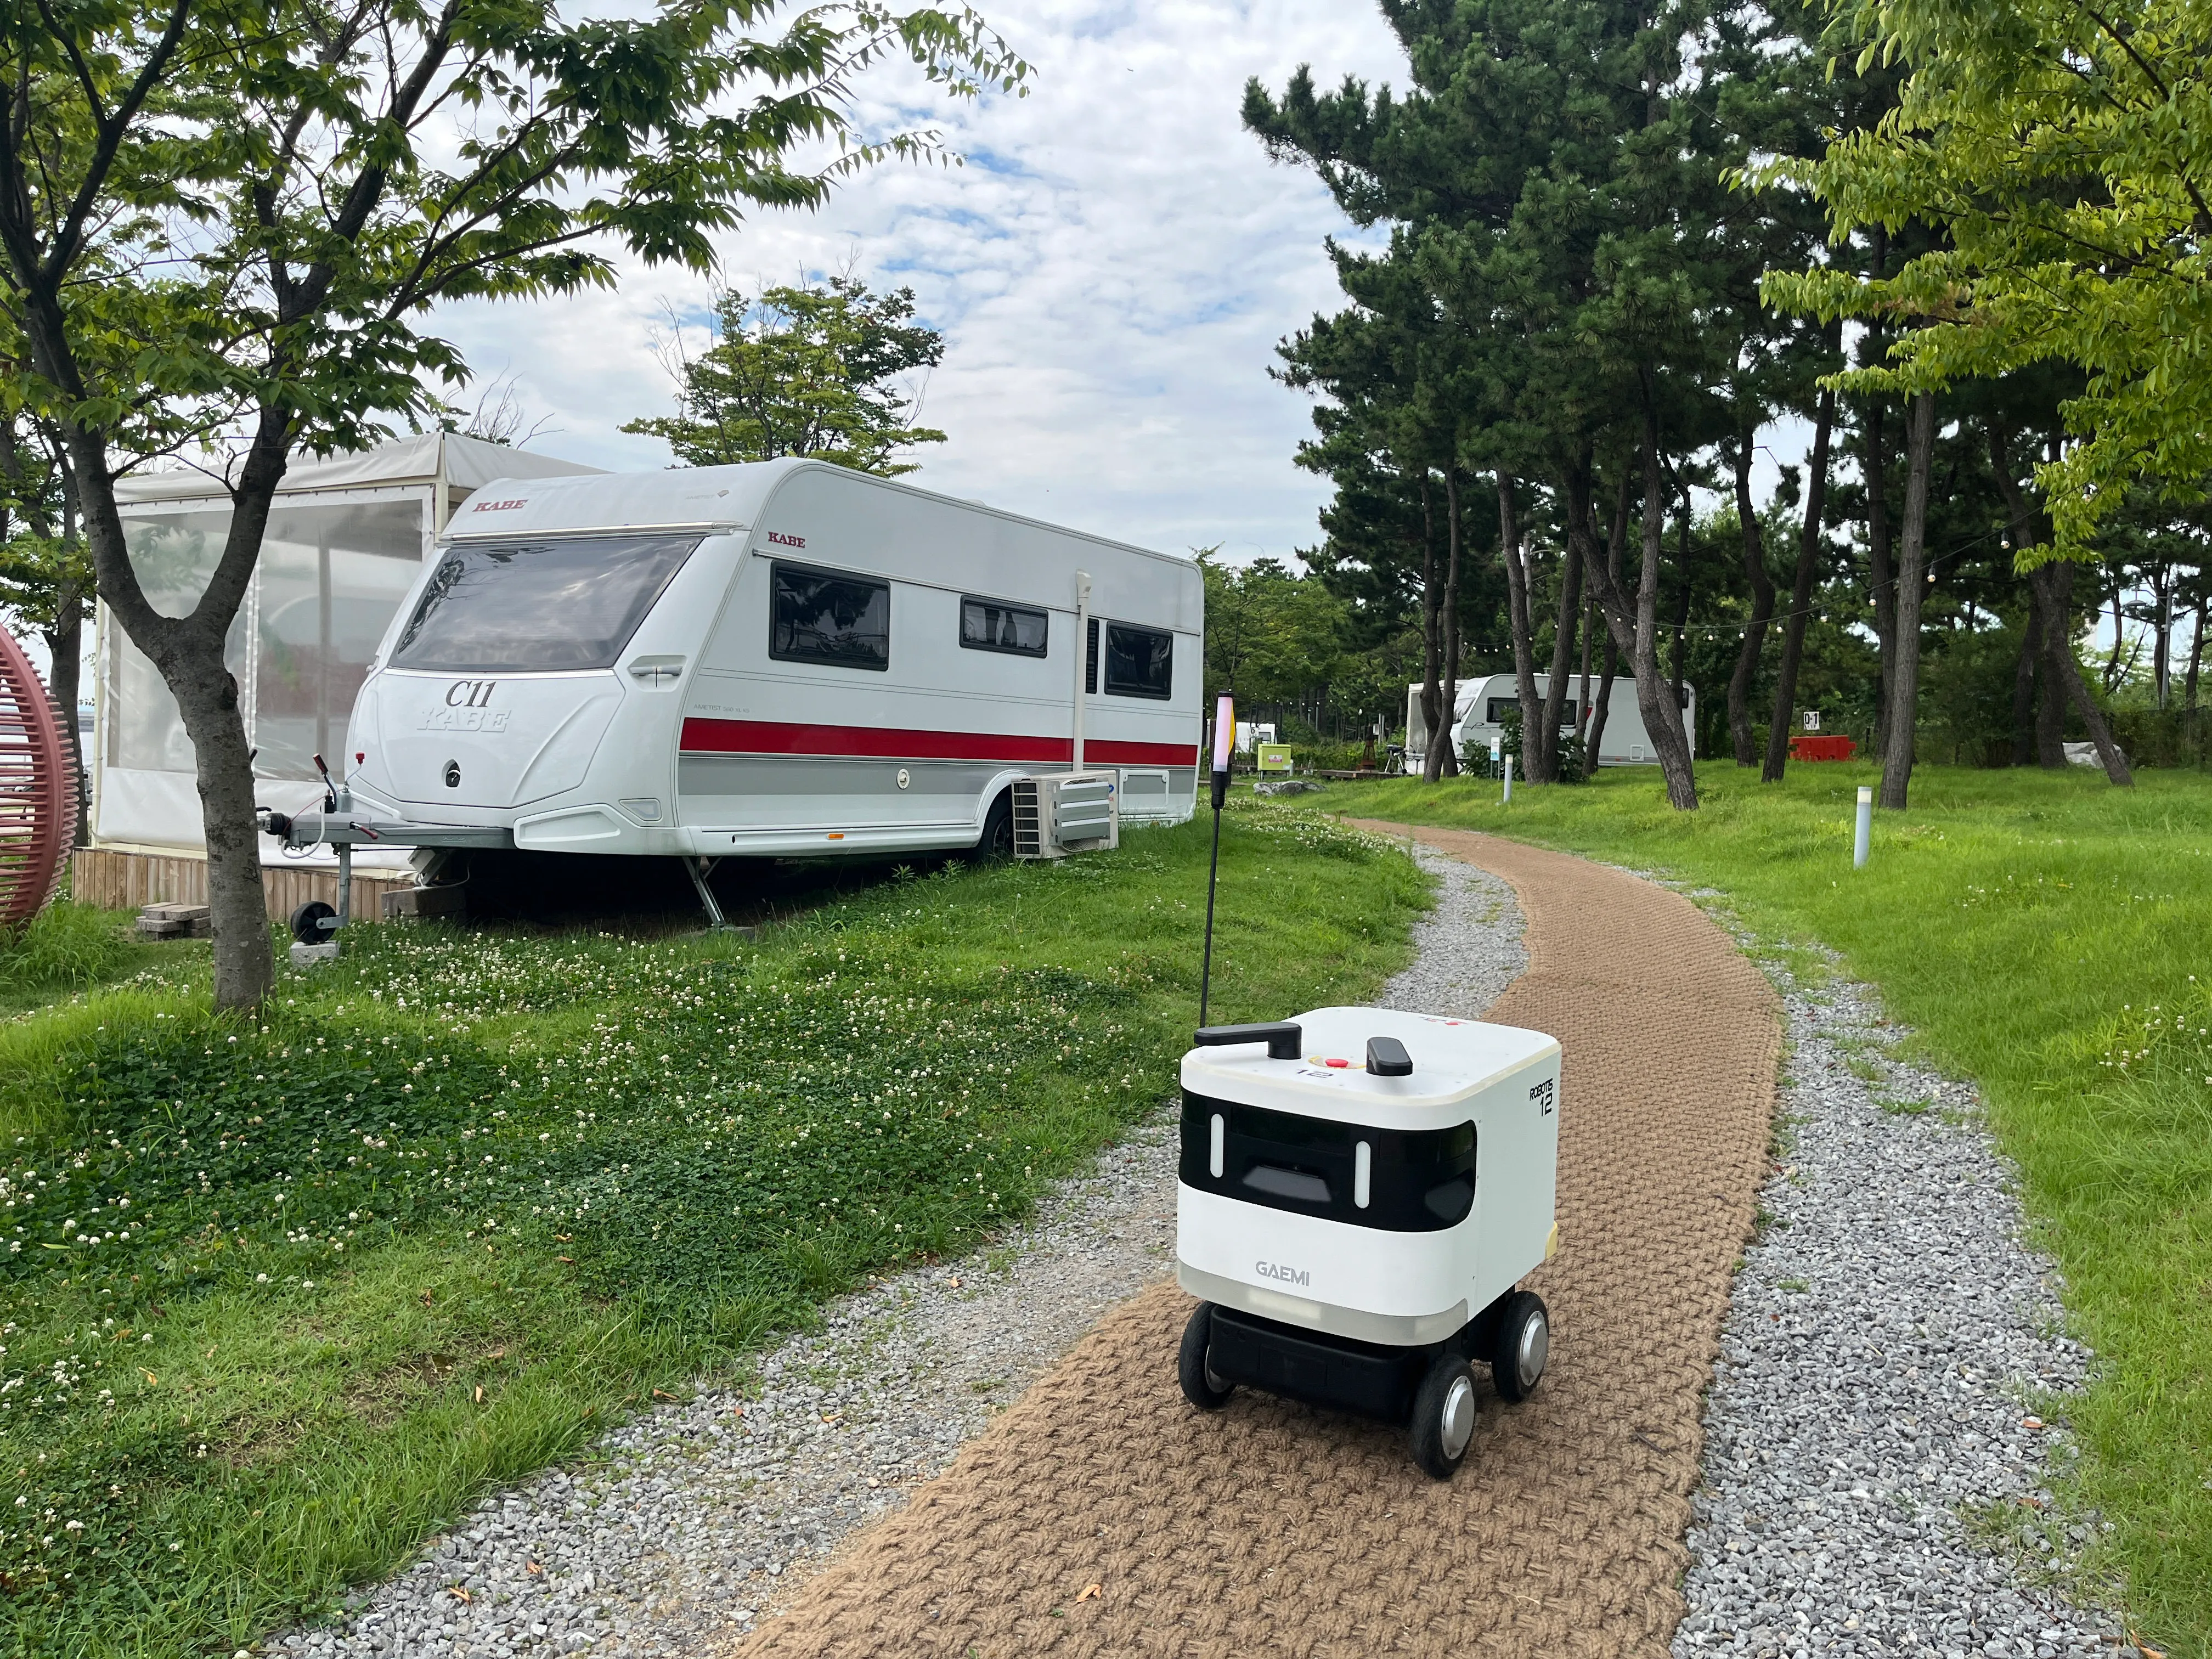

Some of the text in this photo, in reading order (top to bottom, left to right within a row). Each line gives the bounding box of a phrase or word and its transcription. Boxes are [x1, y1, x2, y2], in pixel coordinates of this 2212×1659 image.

[472, 499, 529, 512] KABE
[768, 531, 806, 548] KABE
[445, 680, 496, 708] C11
[416, 707, 512, 733] KABE
[1296, 1069, 1334, 1079] 12
[1529, 1077, 1553, 1102] ROBOTIS
[1539, 1092, 1553, 1117] 12
[1255, 1261, 1310, 1286] GAEMI
